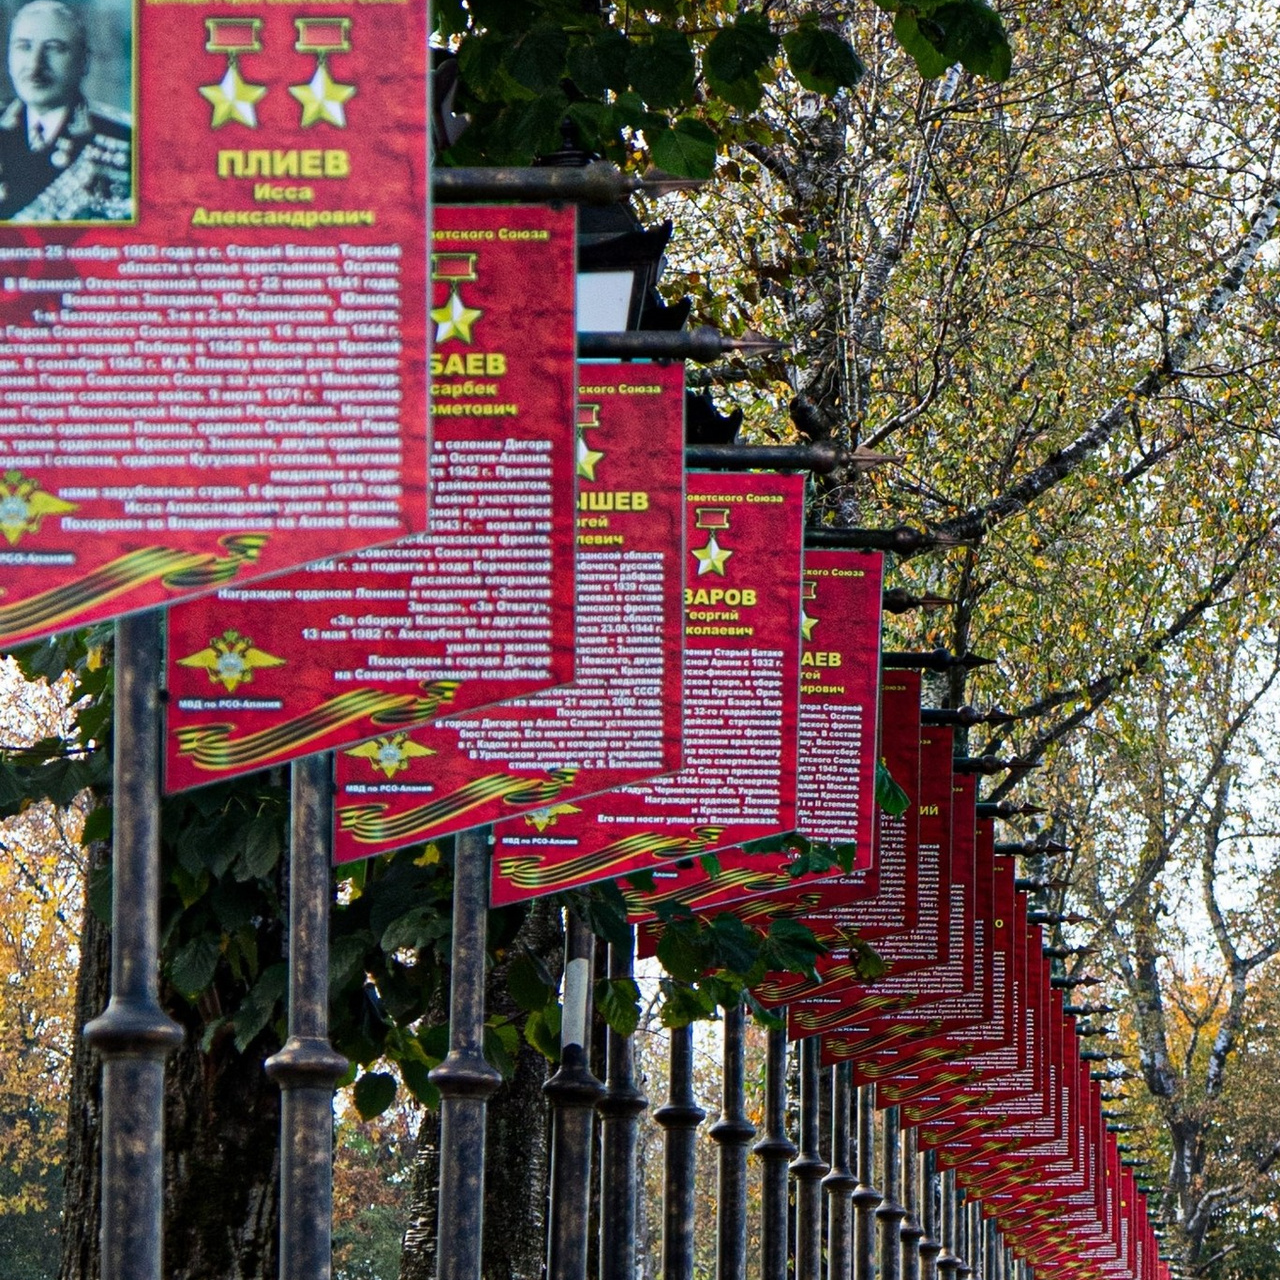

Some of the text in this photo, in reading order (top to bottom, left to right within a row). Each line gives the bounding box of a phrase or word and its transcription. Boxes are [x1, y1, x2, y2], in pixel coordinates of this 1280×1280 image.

[218, 150, 349, 176] ПЛИЕВ
[254, 184, 313, 200] Исса
[191, 210, 374, 226] Александрович
[498, 228, 547, 239] Союза
[217, 587, 551, 600] Награжден орденом Ленина и медалями «Золотая
[469, 600, 493, 611] «За
[330, 614, 550, 627] «За оборону Кавказа» и другими.
[302, 628, 551, 639] 13 мая 1982 г. Ахсарбек Магометович
[368, 654, 551, 666] Похоронен в городе Дигоре
[335, 668, 549, 680] на Северо-Восточном кладбище.
